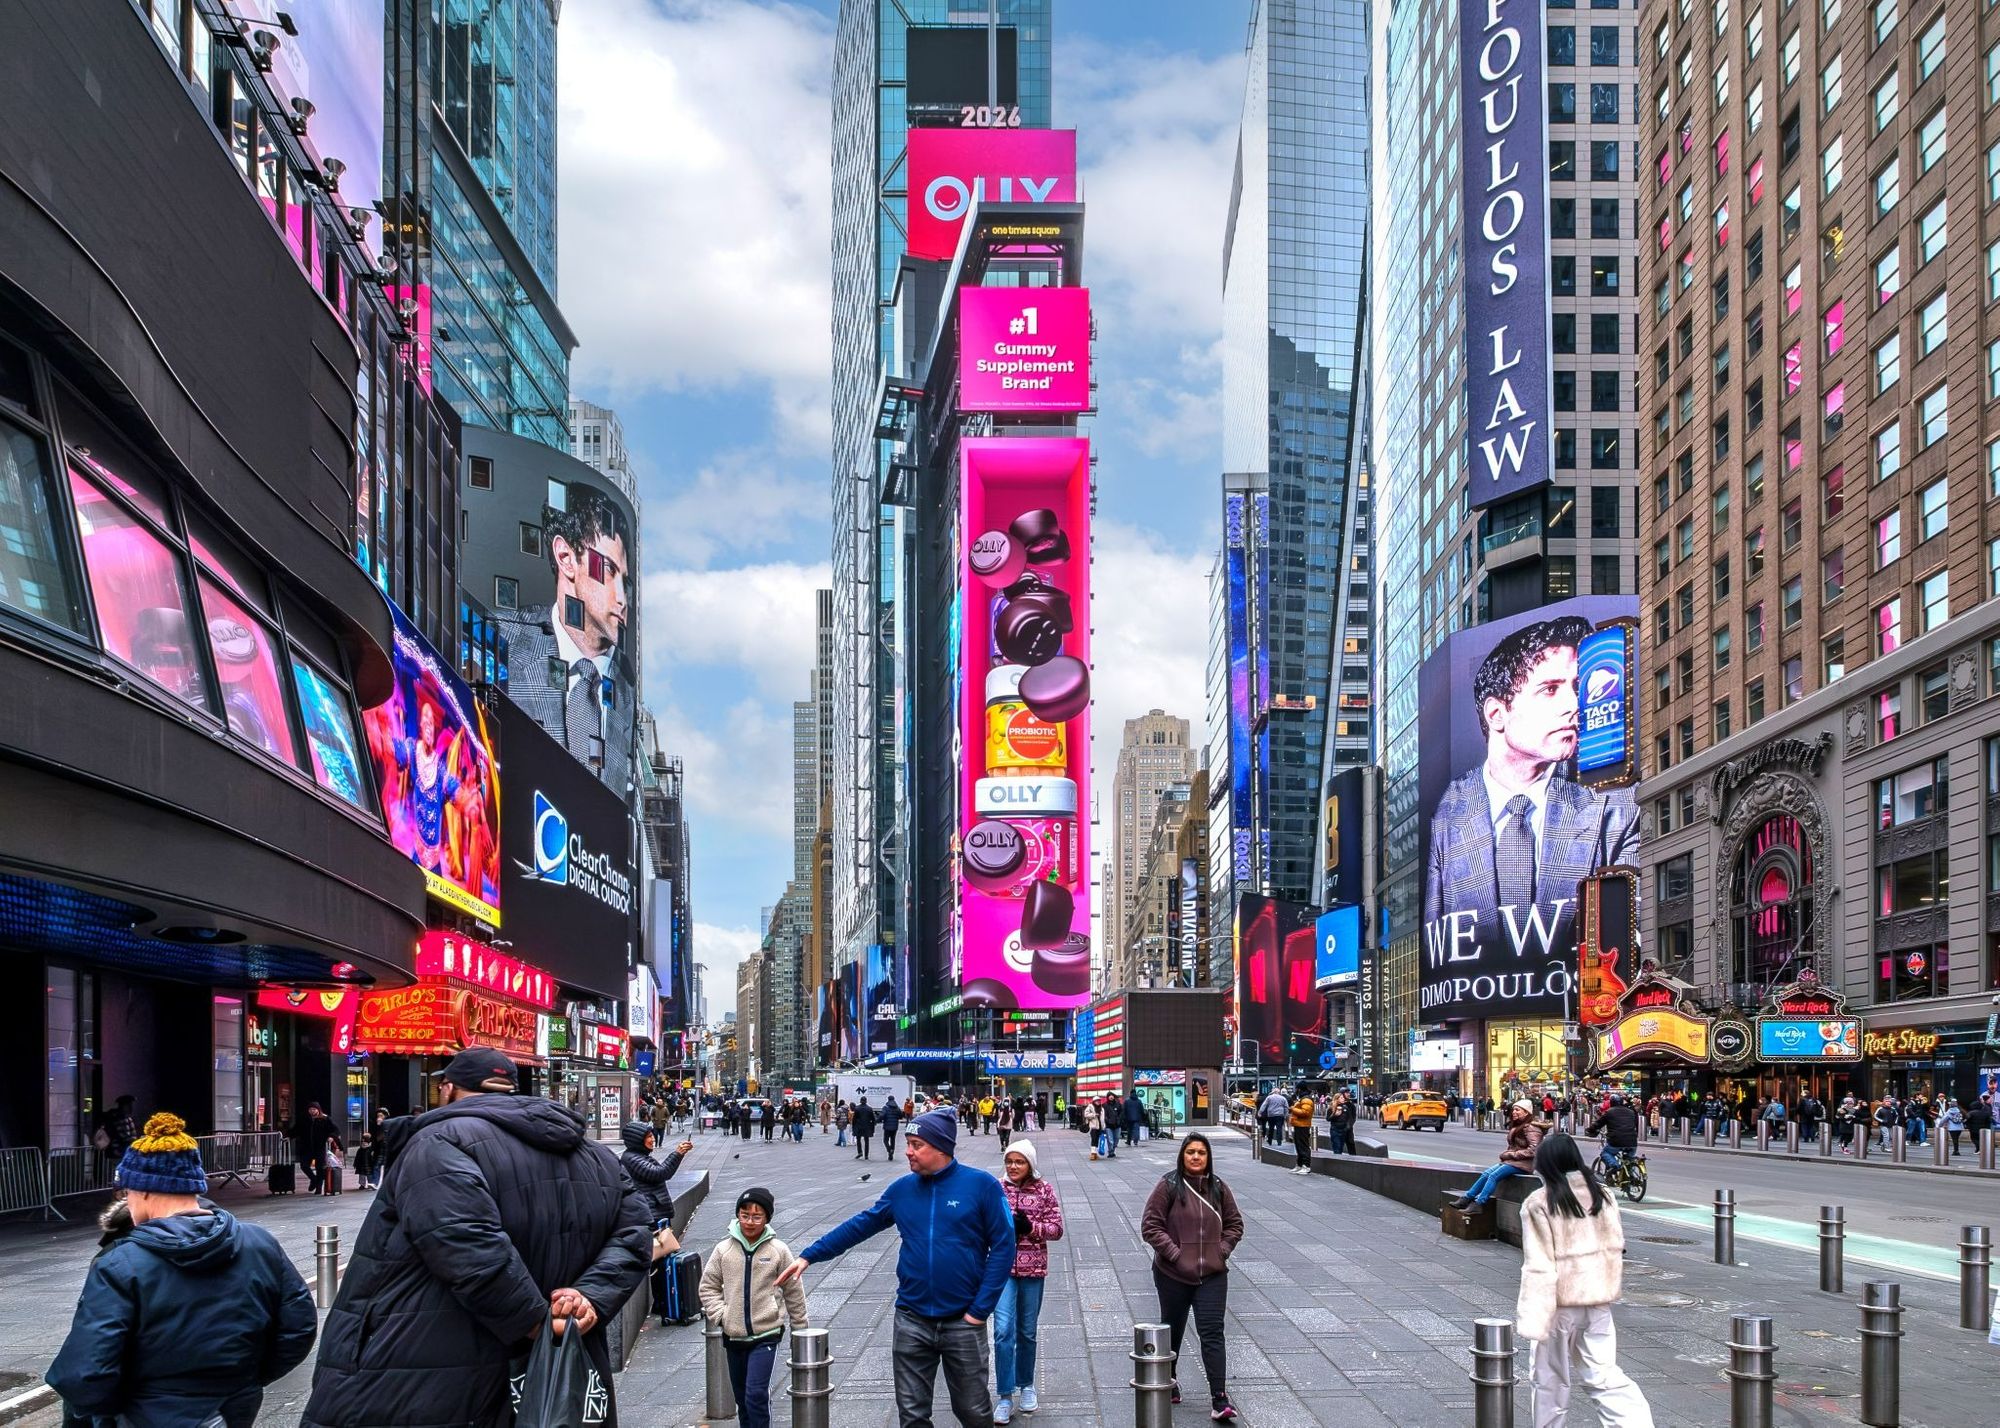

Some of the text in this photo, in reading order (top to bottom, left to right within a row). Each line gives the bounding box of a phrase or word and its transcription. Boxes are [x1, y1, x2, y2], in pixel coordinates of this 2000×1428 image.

[961, 105, 1021, 128] 2026
[992, 225, 1060, 238] one times square
[1009, 306, 1038, 336] #1
[994, 343, 1057, 357] Gummy
[976, 360, 1074, 375] Supplement
[1478, 325, 1537, 481] LAW
[971, 539, 1006, 554] OLLY
[1584, 700, 1620, 720] TACO
[1009, 727, 1056, 736] PROBIOTIC
[1586, 712, 1620, 732] BELL
[989, 785, 1043, 803] OLLY
[968, 831, 1018, 848] OLLY
[569, 863, 600, 899] DIGITAL
[1425, 909, 1482, 969] WE
[1363, 959, 1372, 1009] SQUARE
[362, 989, 436, 1024] CARLO'S
[1637, 990, 1671, 1007] Hard Rock
[1783, 1002, 1830, 1014] Hard Rock
[362, 1026, 434, 1040] BAKE SHOP
[1363, 1022, 1372, 1060] TIMES
[1863, 1028, 1936, 1056] Rock Shop
[1327, 1071, 1358, 1079] CHASE
